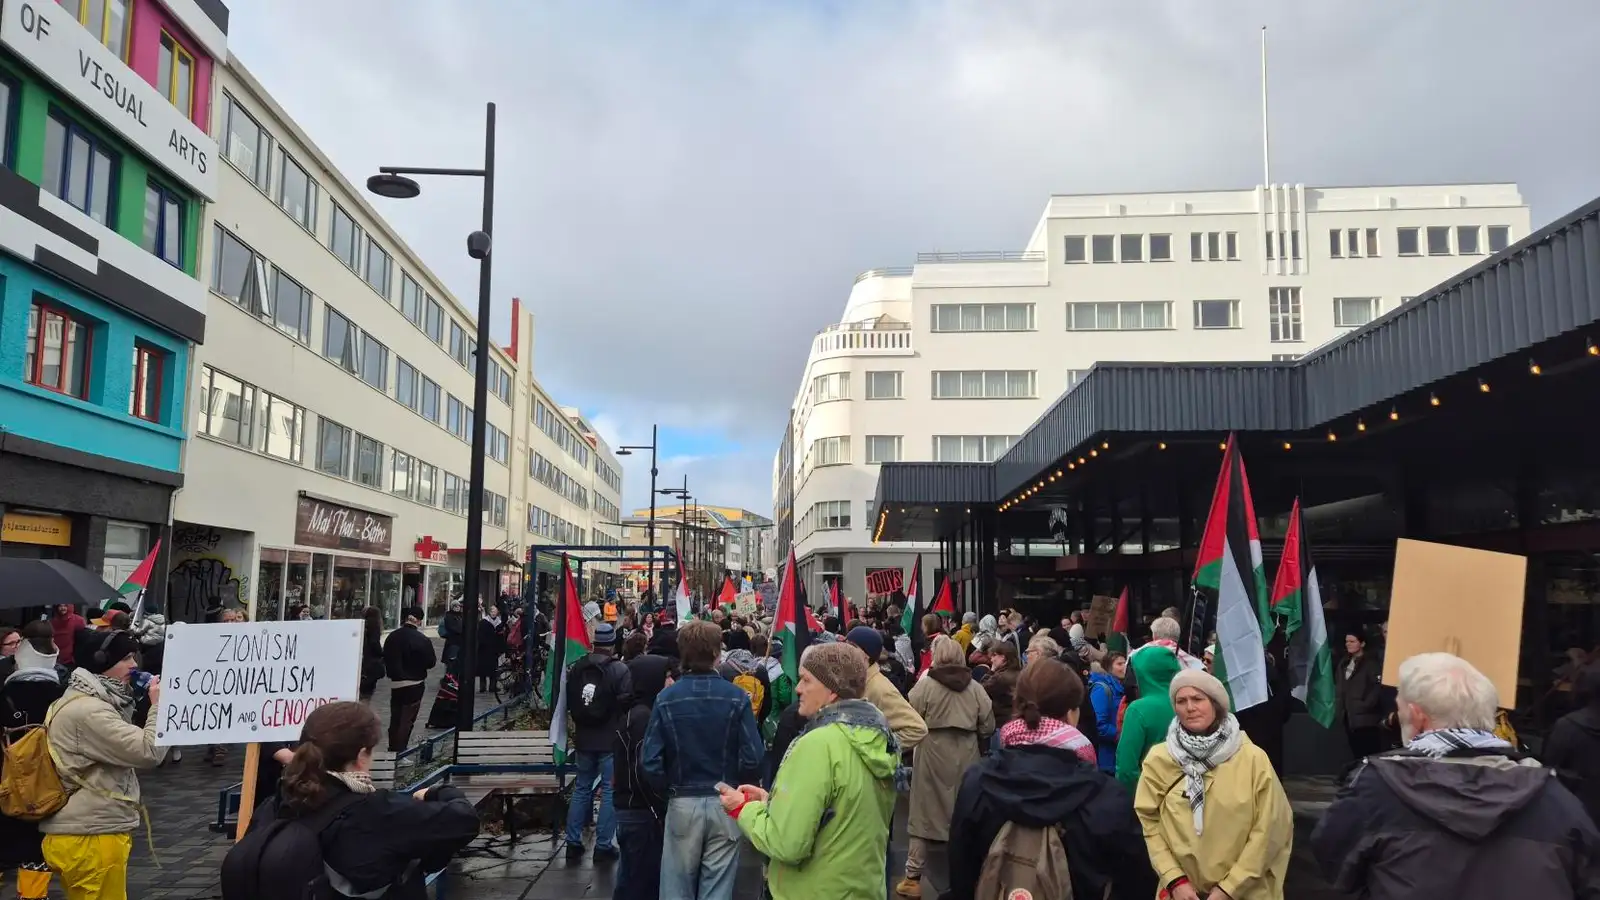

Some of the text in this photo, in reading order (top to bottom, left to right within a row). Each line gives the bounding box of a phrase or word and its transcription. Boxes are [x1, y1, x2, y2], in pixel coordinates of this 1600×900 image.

[20, 3, 207, 174] OF VISUAL ARTS
[307, 504, 333, 535] Mai
[333, 509, 357, 537] Thai
[361, 514, 386, 543] Bistro
[216, 633, 298, 662] ZIONISM
[169, 665, 315, 696] IS COLONIALISM
[166, 697, 338, 732] RACISM AND GENOC
